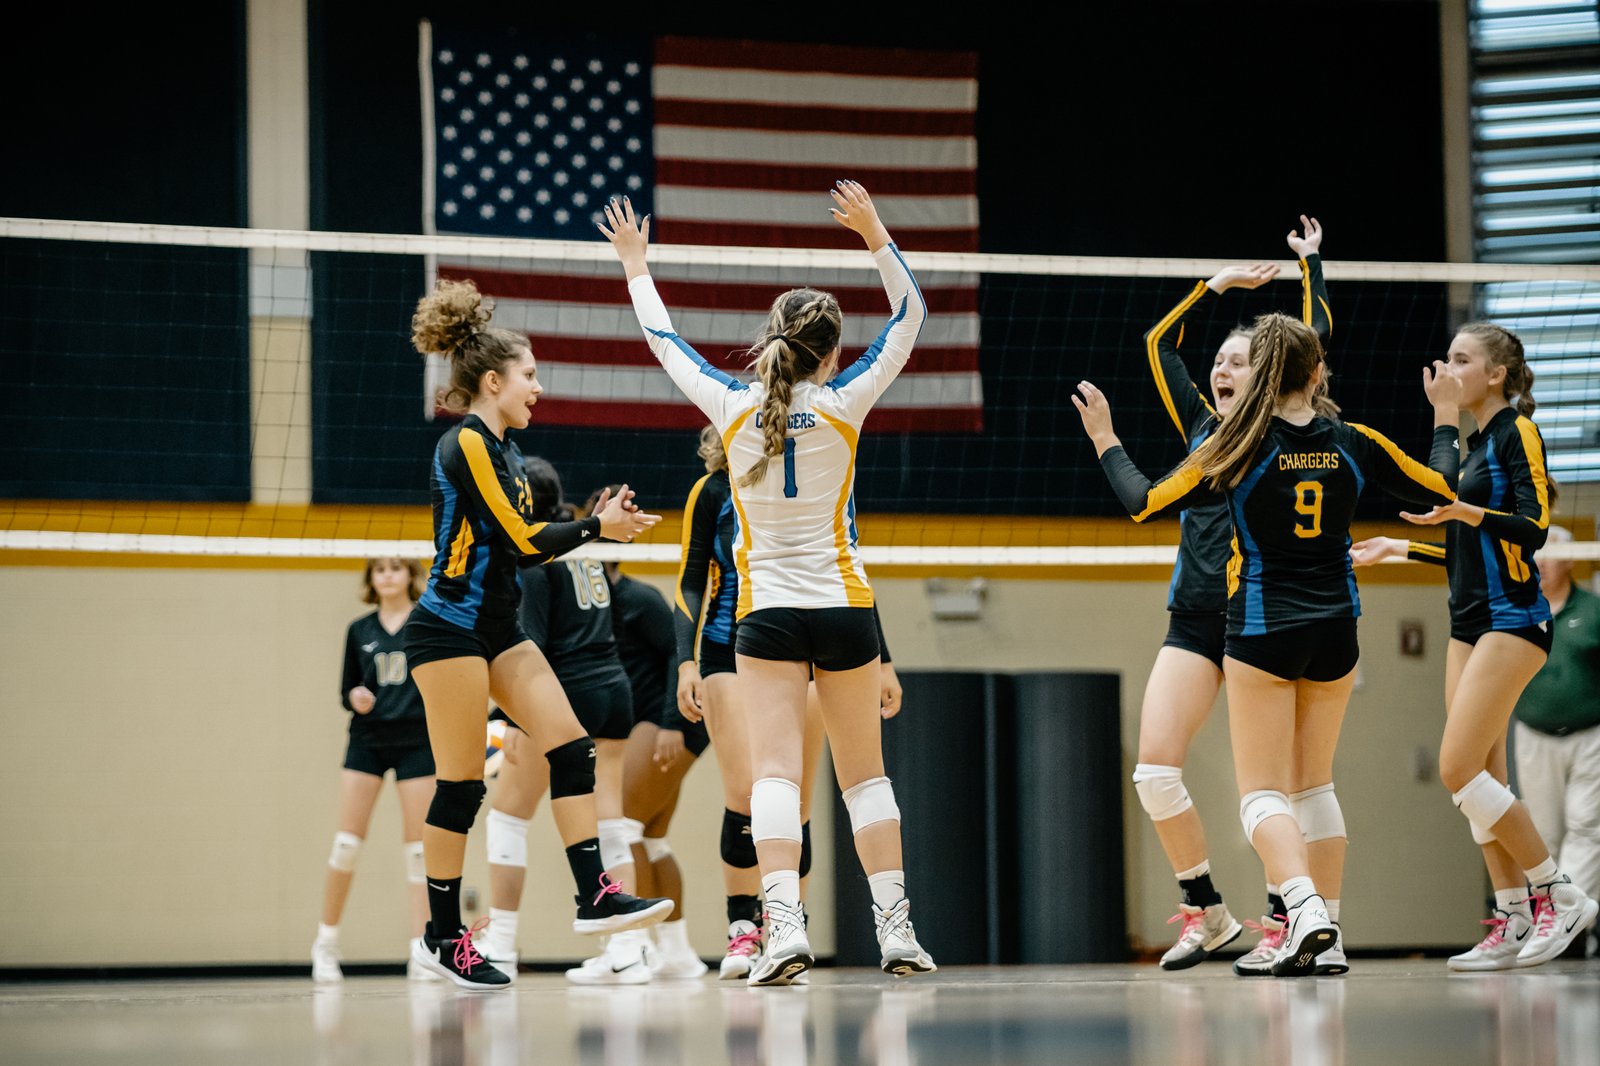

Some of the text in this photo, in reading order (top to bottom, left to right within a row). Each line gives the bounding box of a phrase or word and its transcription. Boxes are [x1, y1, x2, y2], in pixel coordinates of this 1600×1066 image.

[755, 411, 816, 430] CGERS
[783, 437, 798, 498] 1
[1278, 452, 1340, 471] CHARGERS
[1293, 480, 1323, 539] 9
